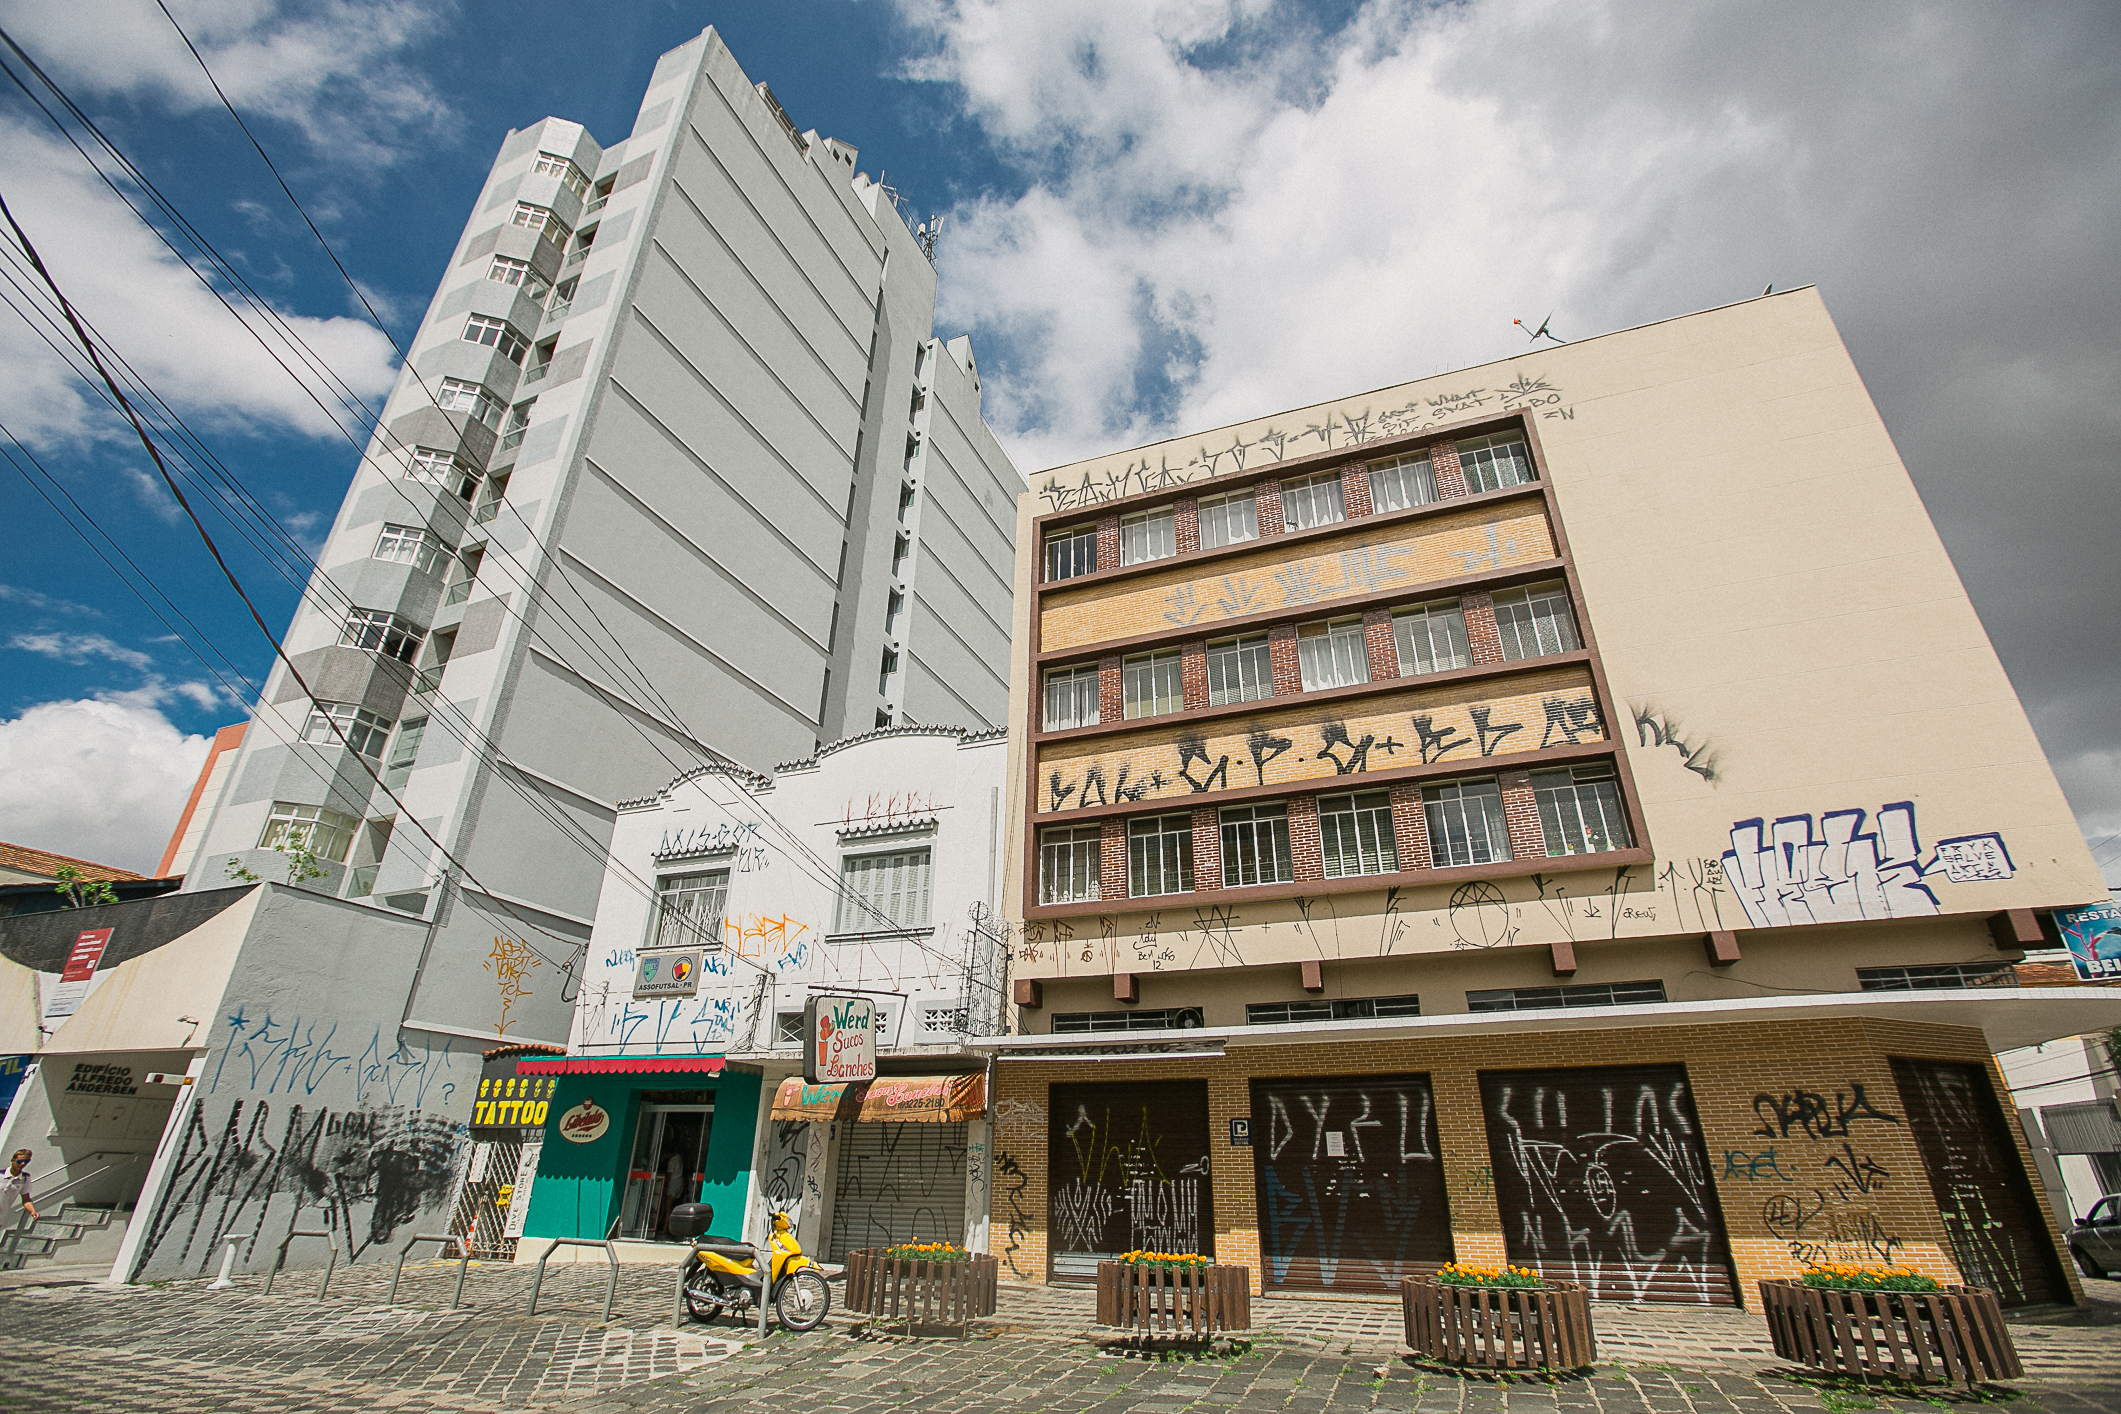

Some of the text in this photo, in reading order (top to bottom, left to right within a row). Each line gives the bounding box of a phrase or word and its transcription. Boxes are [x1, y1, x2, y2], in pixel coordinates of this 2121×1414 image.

[2065, 907, 2121, 923] RESTA
[833, 1001, 870, 1029] Werd
[832, 1030, 864, 1053] Sucos
[74, 1063, 131, 1076] EDIFÍCIO
[826, 1054, 874, 1078] Lanches
[65, 1082, 138, 1095] ANDERSEN
[70, 1073, 133, 1086] ALFREDO
[856, 1084, 893, 1103] Sucos
[475, 1101, 549, 1126] TATTOO
[508, 1207, 519, 1230] DIVE
[516, 1171, 528, 1201] STORE
